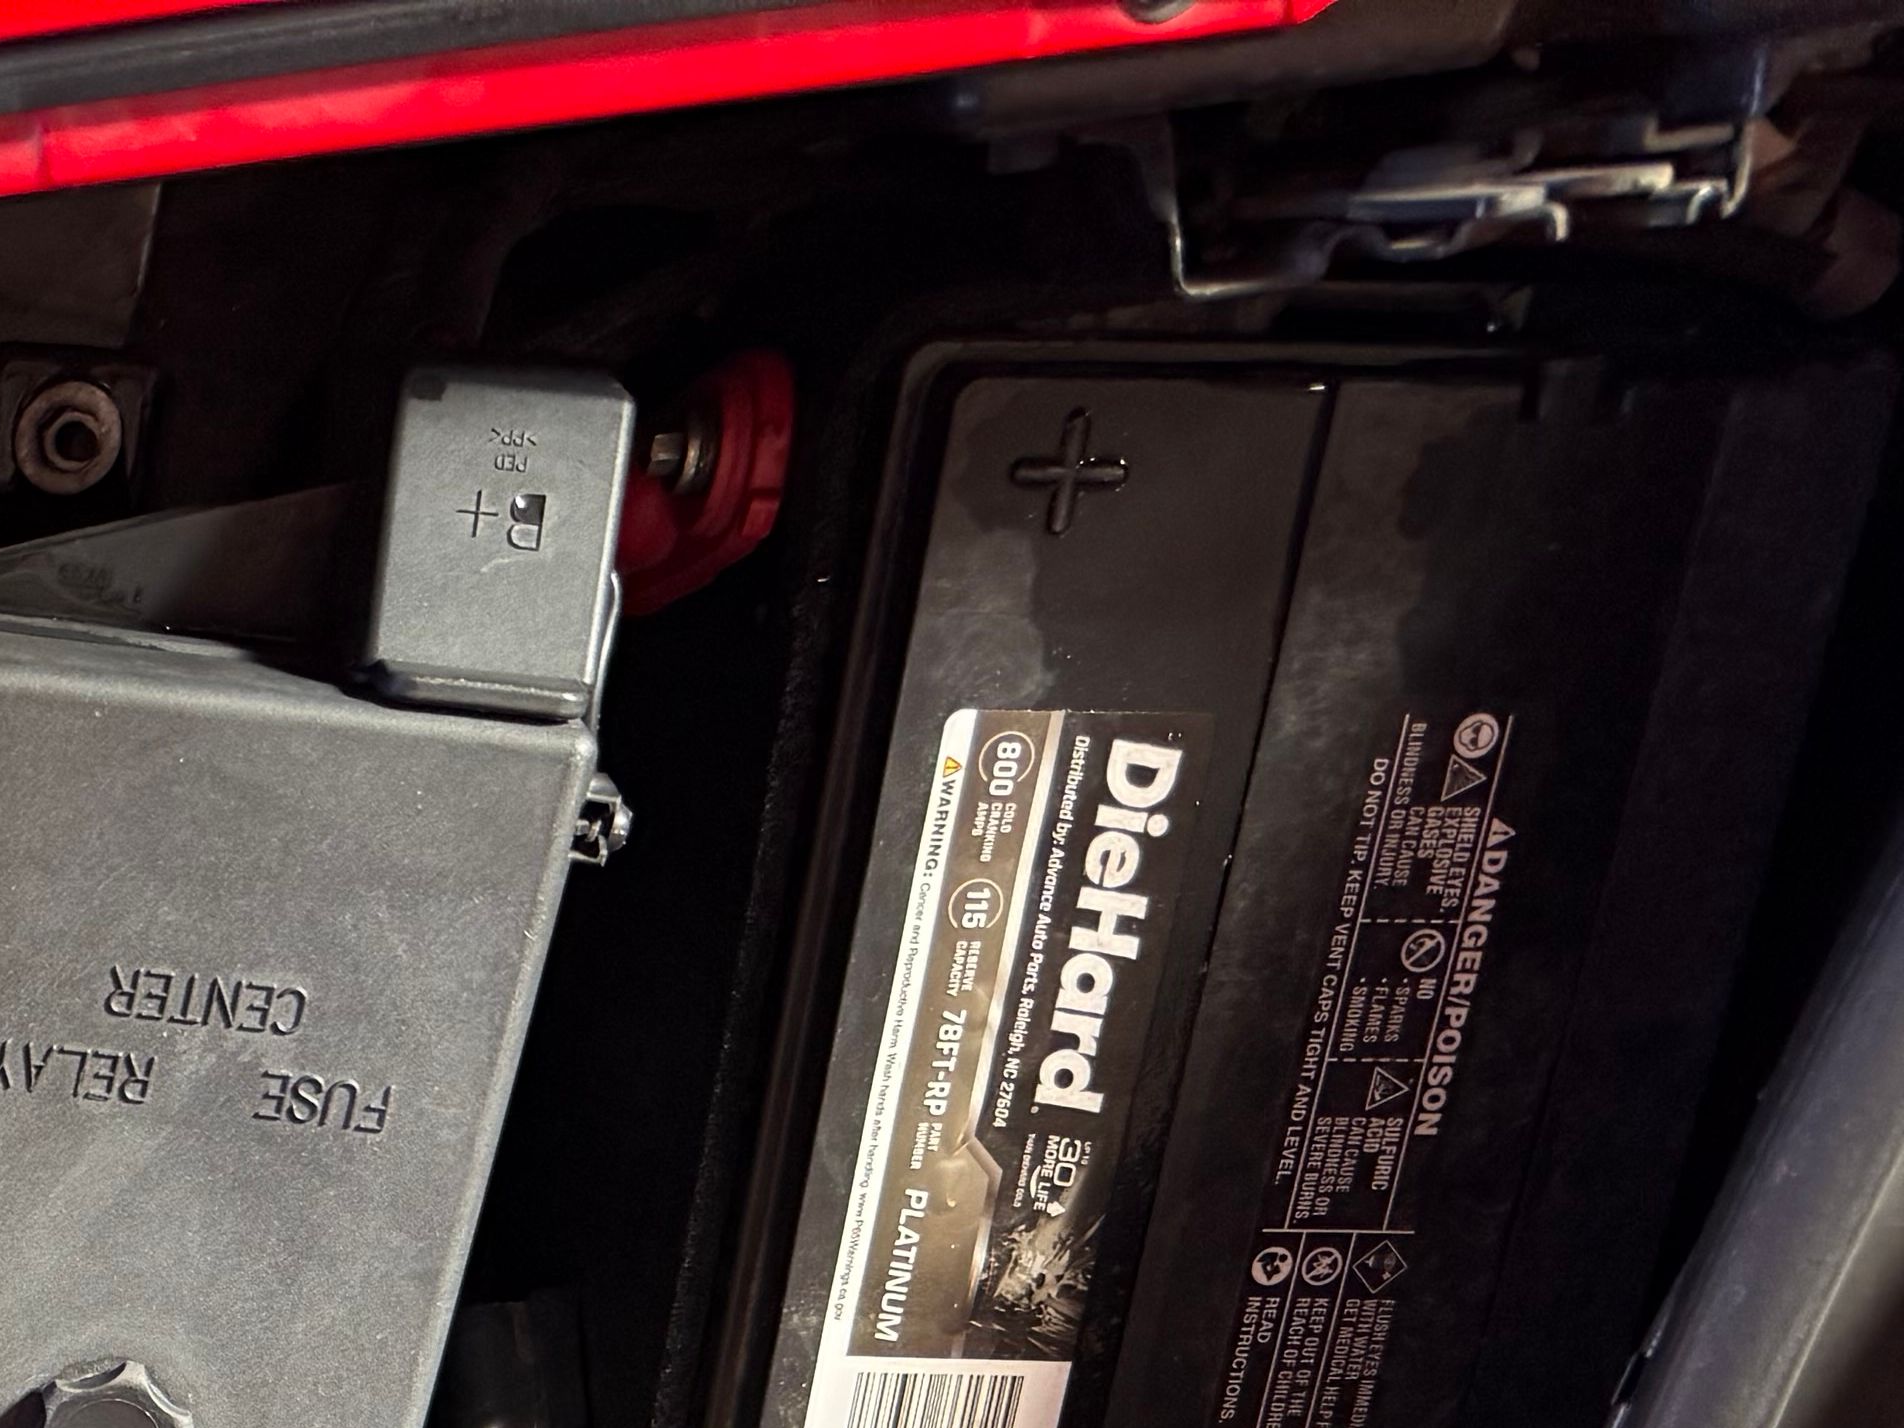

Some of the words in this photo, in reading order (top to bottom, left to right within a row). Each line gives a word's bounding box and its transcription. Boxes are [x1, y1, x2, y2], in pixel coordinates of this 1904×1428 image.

[494, 454, 528, 473] PED
[456, 489, 547, 552] B+
[988, 741, 1021, 795] 800
[1058, 734, 1090, 820] Distributed
[1369, 756, 1390, 785] DO
[922, 779, 955, 876] WARNING:
[1051, 821, 1072, 845] by:
[1359, 789, 1382, 828] NOT
[1350, 832, 1371, 864] TIP.
[1039, 846, 1065, 911] Advance
[1339, 869, 1363, 918] KEEP
[961, 887, 990, 928] 115
[1031, 913, 1051, 950] Auto
[1034, 739, 1183, 1113] DieHard
[946, 940, 967, 996] CAPACITY
[1325, 922, 1351, 970] VENT
[1021, 952, 1044, 994] Parts,
[1313, 974, 1338, 1023] CAPS
[1415, 850, 1508, 1135] DANGER/POISON
[1416, 977, 1437, 999] NO
[103, 964, 309, 1036] CENTER
[1007, 997, 1034, 1054] Raleigh,
[1339, 985, 1368, 1051] SMOKING
[1362, 986, 1389, 1043] FLAMES
[1383, 986, 1411, 1042] SPARKS
[923, 1009, 966, 1115] 78FT-RP
[1002, 1057, 1020, 1079] NC
[1299, 1026, 1326, 1080] TIGHT
[252, 1069, 394, 1135] FUSE
[992, 1080, 1015, 1127] 27604
[1290, 1083, 1312, 1121] AND
[1040, 1134, 1060, 1177] MORE
[1274, 1125, 1303, 1185] LEVEL.
[1362, 1116, 1385, 1152] ACID
[1370, 1116, 1404, 1190] SULFURIC
[1053, 1137, 1082, 1188] 30
[1032, 1181, 1050, 1210] LIFE
[874, 1188, 928, 1341] PLATINUM
[1256, 1296, 1280, 1343] READ
[1218, 1296, 1263, 1423] INSTRUCTIONS.
